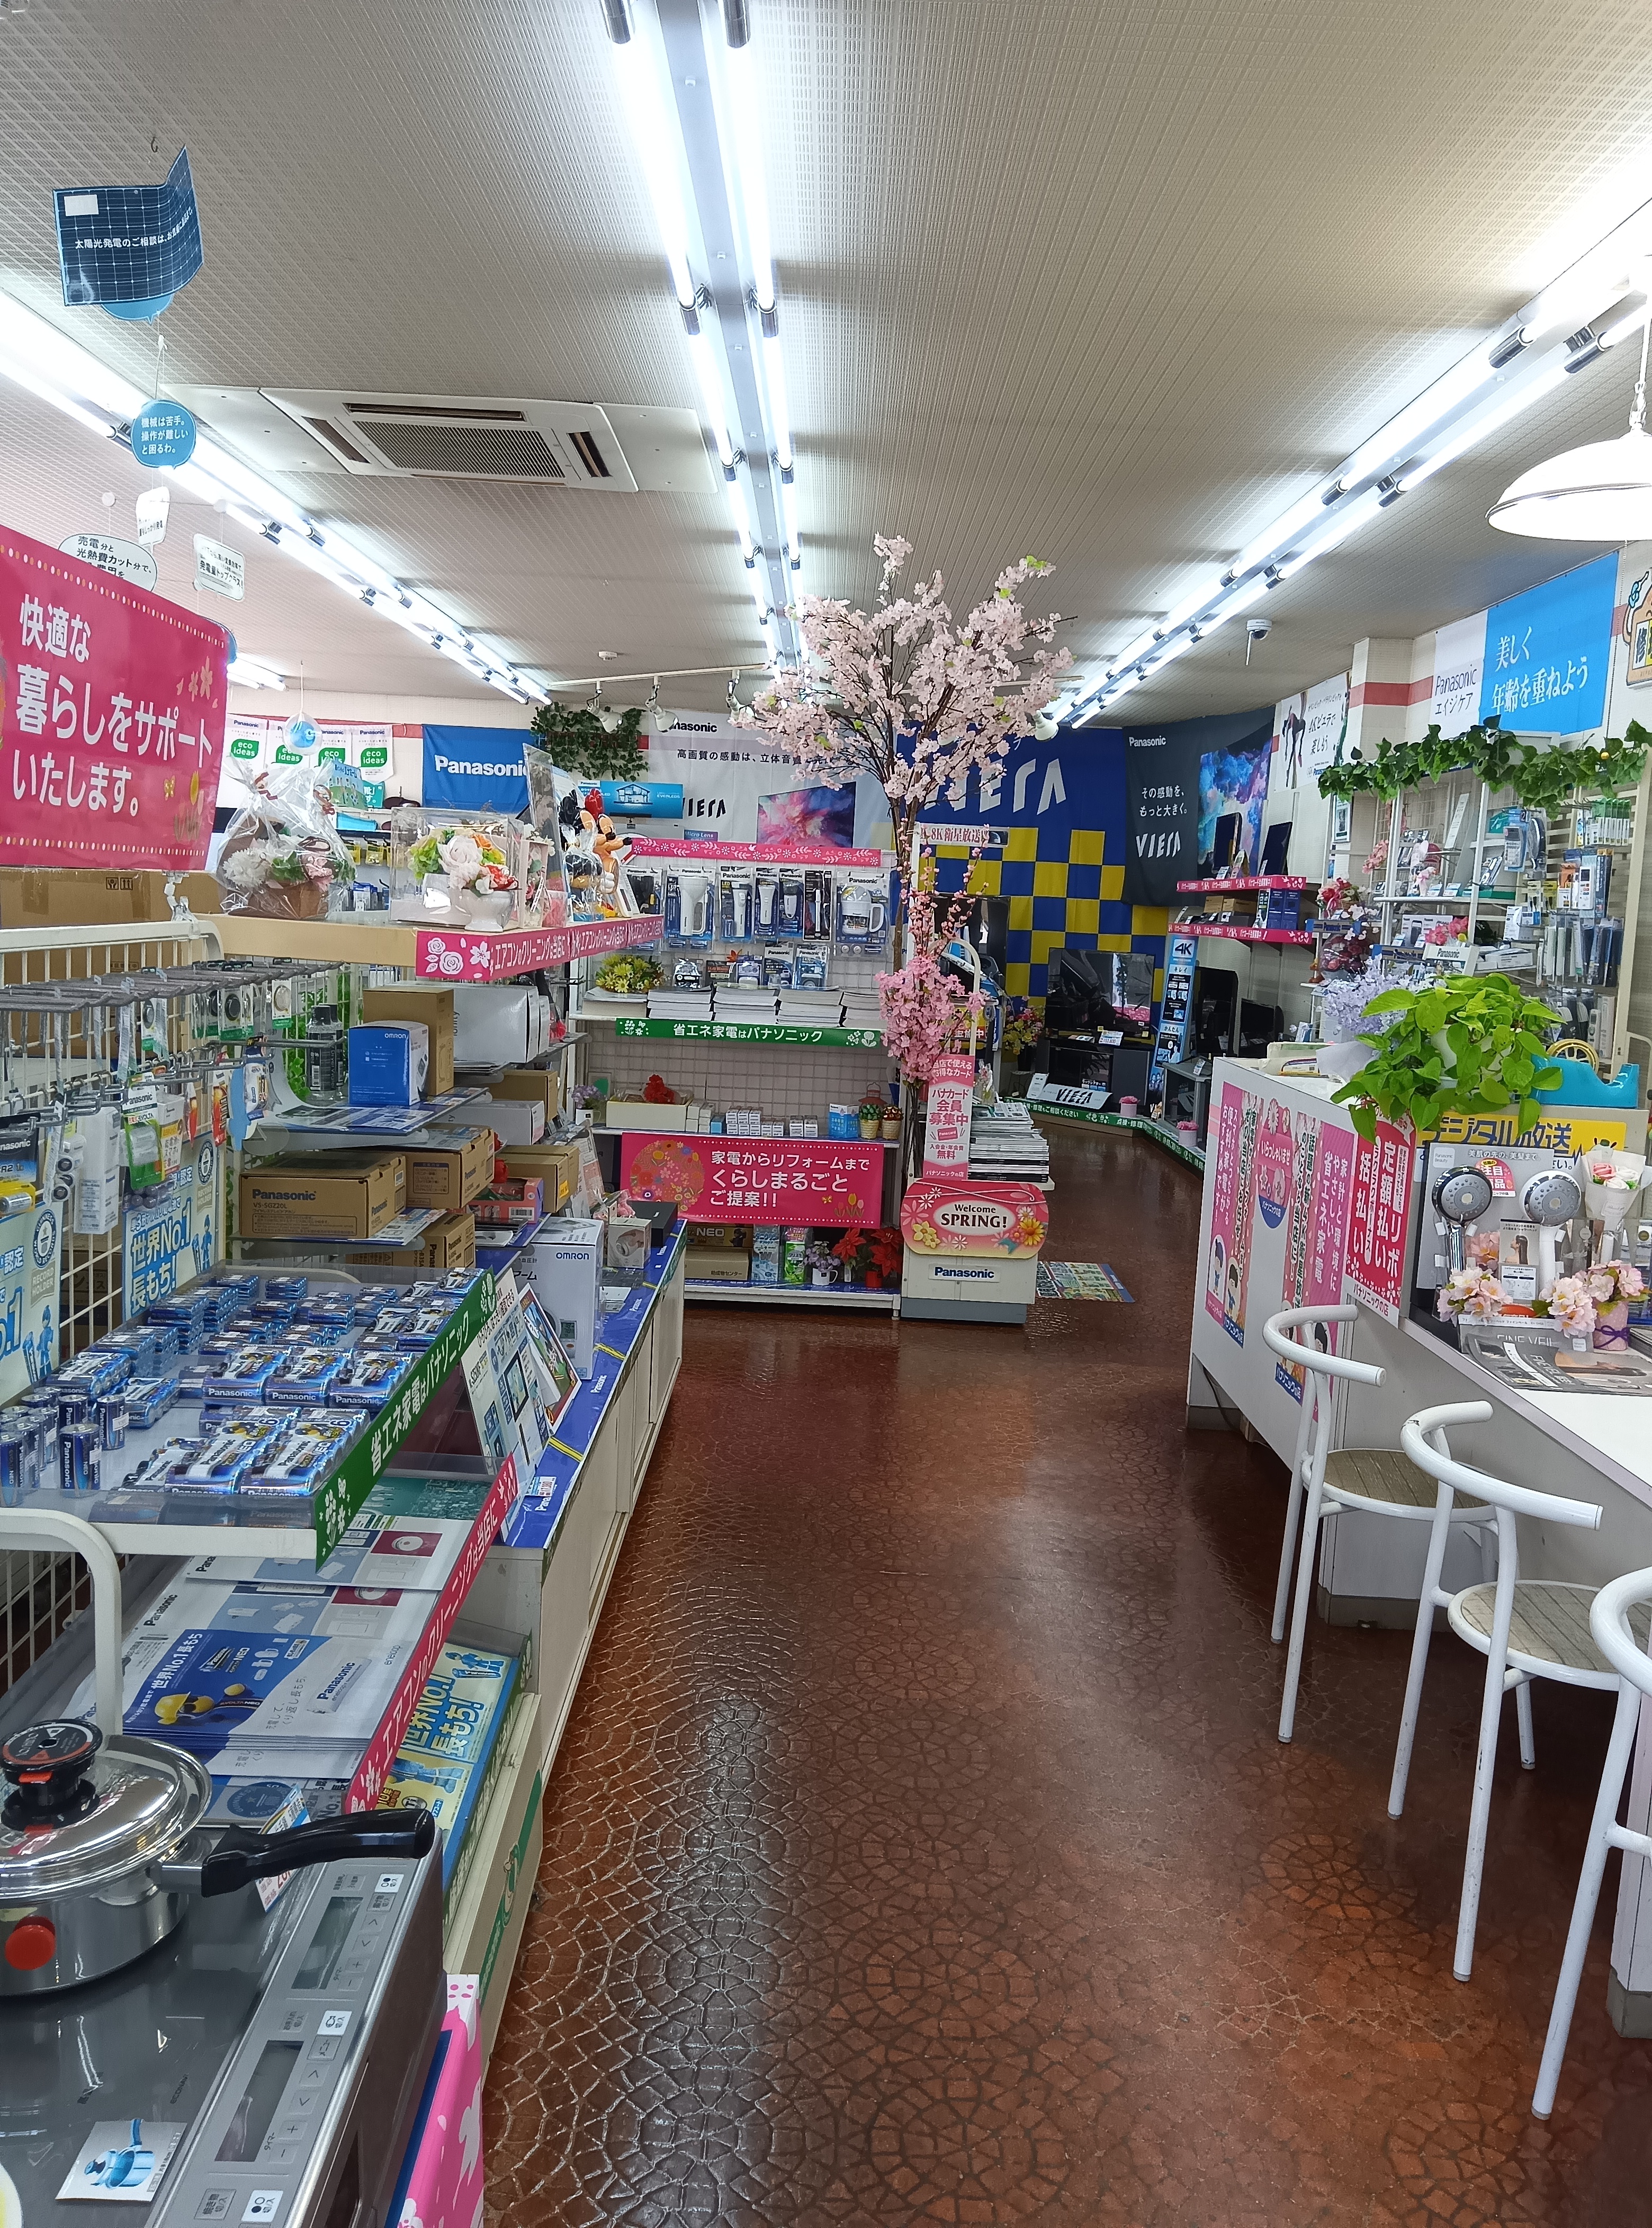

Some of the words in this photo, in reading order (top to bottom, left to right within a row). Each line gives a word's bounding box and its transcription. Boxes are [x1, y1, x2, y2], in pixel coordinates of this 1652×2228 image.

[141, 416, 185, 428] 機械は苦手。
[141, 429, 188, 442] 操作が難しい
[141, 442, 176, 455] と困るわ。
[78, 536, 114, 552] 売電分と
[77, 547, 151, 573] 光熱費カット分で、
[20, 592, 91, 664] 快適な
[1496, 626, 1532, 672] 美しく
[1435, 664, 1478, 696] Panasonic
[1491, 656, 1588, 714] 年齢を重ねよう
[1435, 692, 1474, 716] エイジケア
[15, 663, 212, 768] 暮らしをサポート
[234, 720, 259, 728] Panasonic
[1129, 735, 1166, 747] Panasonic
[234, 747, 255, 757] ideas
[279, 753, 300, 762] ideas
[435, 754, 528, 777] Panasonic
[13, 749, 139, 817] いたします。
[1142, 785, 1184, 799] その感動を、
[1139, 804, 1187, 817] もっと大きく。
[1136, 831, 1181, 859] VIERA
[1175, 943, 1192, 955] 4K
[1436, 948, 1460, 958] Panasonic
[673, 1022, 823, 1043] 省エネ家電はパナソニック
[932, 1088, 969, 1100] パナカード
[937, 1099, 963, 1112] 会員
[1025, 1102, 1079, 1118] 検・修理もご相談ください
[929, 1112, 968, 1126] 募集中
[0, 1139, 31, 1151] nasonic
[1261, 1140, 1291, 1166] いらっしゃいませ
[711, 1150, 869, 1171] 家電からリフォームまで
[937, 1150, 956, 1160] 無料
[1215, 1103, 1227, 1222] おすすめです!
[1220, 1106, 1234, 1212] 便利家電が
[1468, 1149, 1541, 1161] 美肌の先の、美髪まで。
[1225, 1109, 1238, 1225] スマホとつながる
[1481, 1165, 1504, 1176] 注目
[713, 1169, 848, 1192] くらしまるごと
[252, 1188, 316, 1201] Panasonic
[710, 1190, 776, 1208] ご提案!!
[1239, 1110, 1257, 1281] 家電からリフォームまで
[1327, 1155, 1340, 1238] やさしい
[954, 1203, 996, 1214] Welcome
[1262, 1200, 1281, 1218] パナソニックの店
[1290, 1131, 1307, 1281] のことなら当店に!
[940, 1213, 1008, 1229] SPRING!
[1315, 1151, 1333, 1284] 省エネ家電
[1330, 1158, 1348, 1292] 家計と環境に
[131, 1197, 192, 1273] 世界No.1
[696, 1228, 725, 1236] NEO
[555, 1252, 589, 1260] OMRON
[759, 1251, 773, 1260] W
[32, 1267, 54, 1287] RECORD
[131, 1254, 177, 1310] 長もち!
[934, 1266, 995, 1280] Panasonic
[32, 1278, 53, 1297] HOLDER
[1353, 1283, 1389, 1317] パナソニックの店
[209, 1388, 253, 1398] Panasonic
[590, 1375, 607, 1394] Panasonic
[272, 1392, 316, 1402] Panasonic
[336, 1396, 380, 1405] Panasonic
[371, 1311, 470, 1478] 省エネ家電はパナソニック
[143, 1594, 178, 1627] Panasonic
[383, 1497, 499, 1771] エアコンのクリーニングは当店に
[151, 1632, 203, 1690] 世界No.1長もち
[384, 1645, 401, 1665] eneloop
[316, 1661, 355, 1701] Panasonic
[431, 1697, 484, 1758] 長もち!
